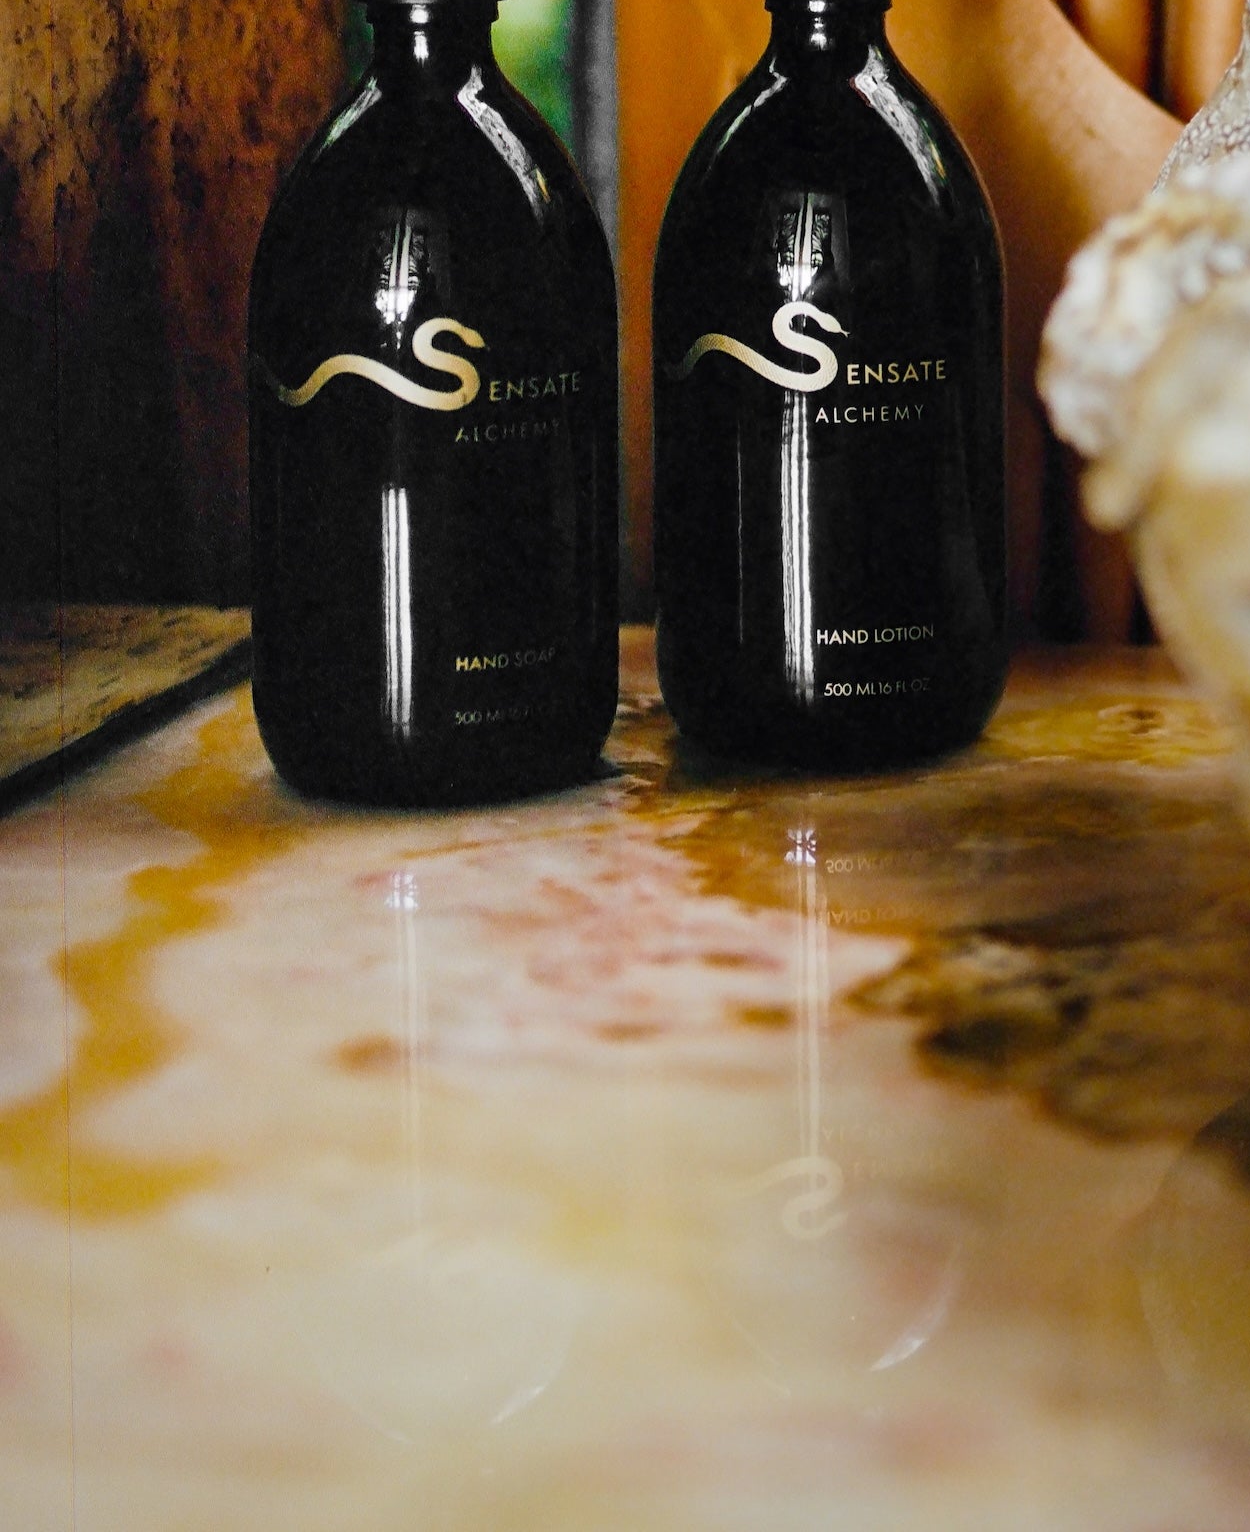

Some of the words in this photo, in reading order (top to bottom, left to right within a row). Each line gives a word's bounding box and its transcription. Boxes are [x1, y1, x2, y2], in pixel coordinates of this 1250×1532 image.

[768, 301, 947, 393] SENSATE
[815, 404, 925, 424] ALCHEMY
[816, 628, 869, 645] HAND
[874, 623, 935, 644] LOTION
[455, 652, 509, 672] HAND
[823, 682, 853, 697] 500
